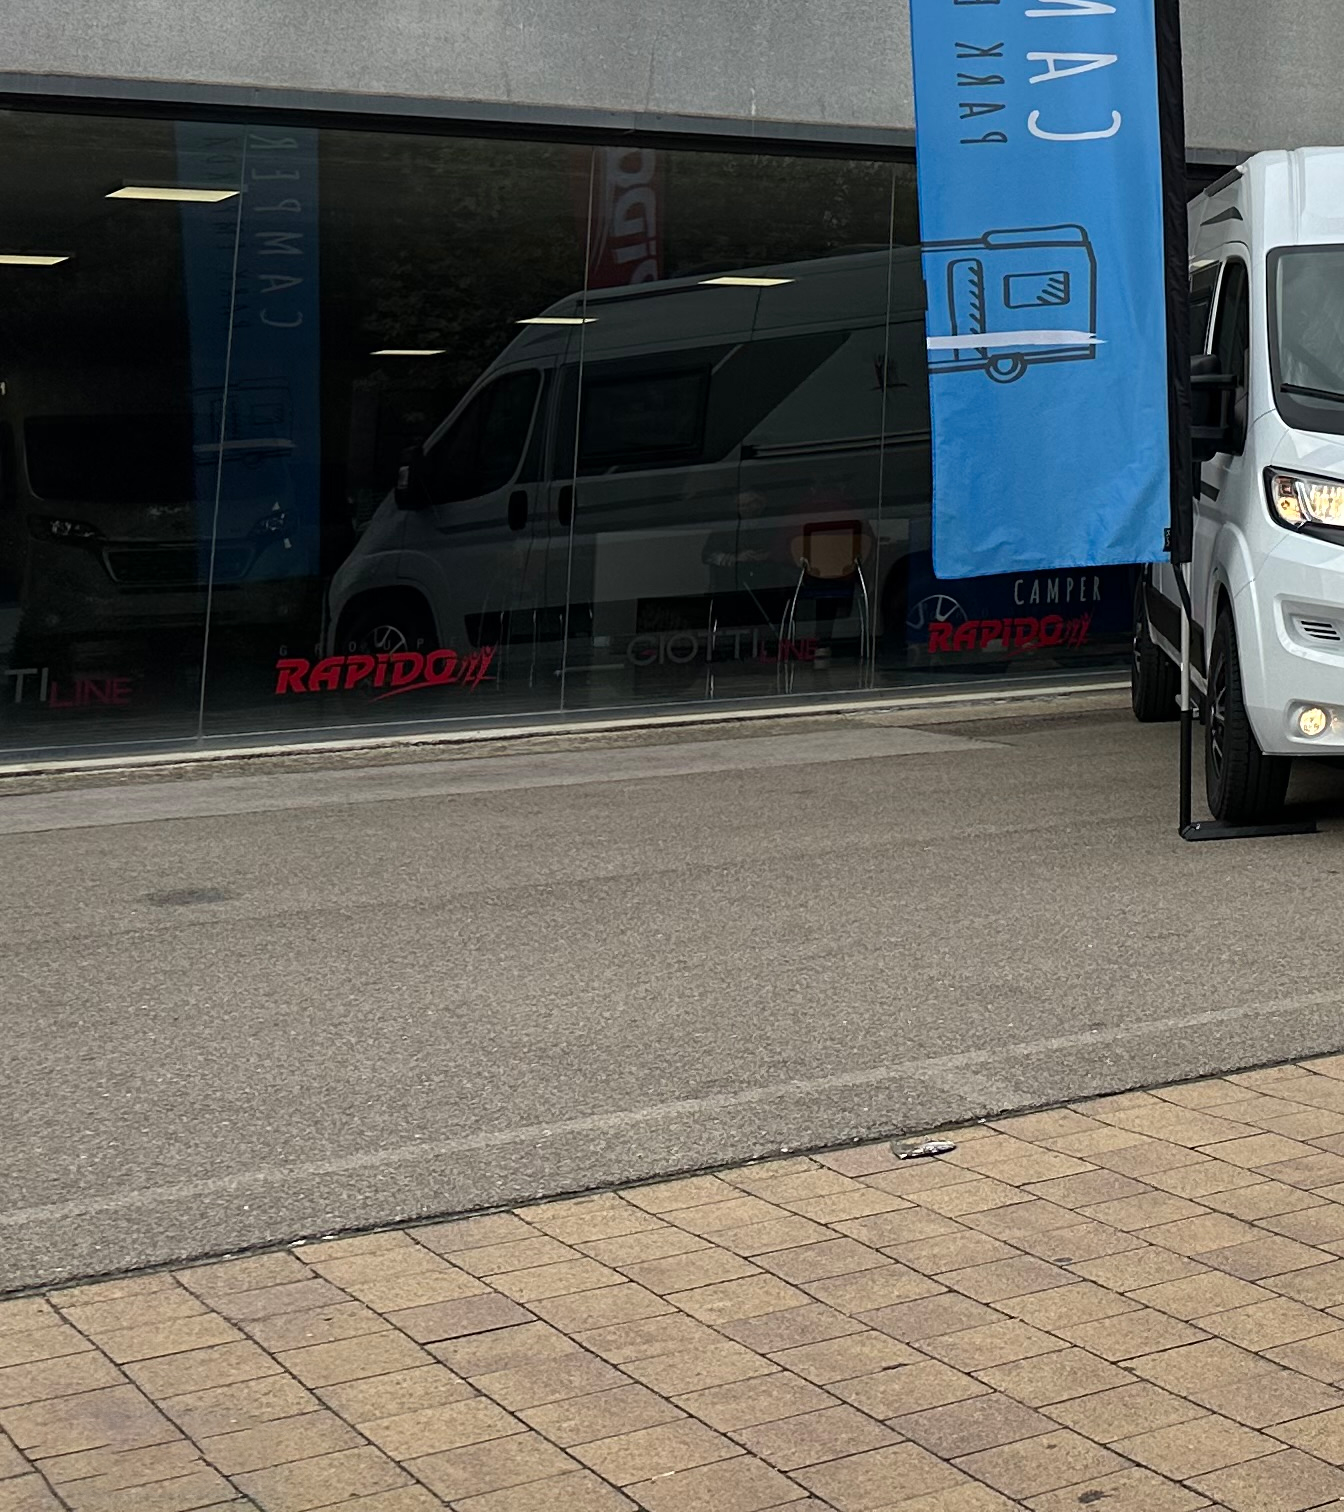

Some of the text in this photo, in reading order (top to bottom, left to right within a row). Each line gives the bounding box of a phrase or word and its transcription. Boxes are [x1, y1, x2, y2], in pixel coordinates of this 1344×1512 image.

[1014, 575, 1101, 605] CAMPER
[279, 637, 457, 657] GROUP
[4, 667, 133, 710] TILINE
